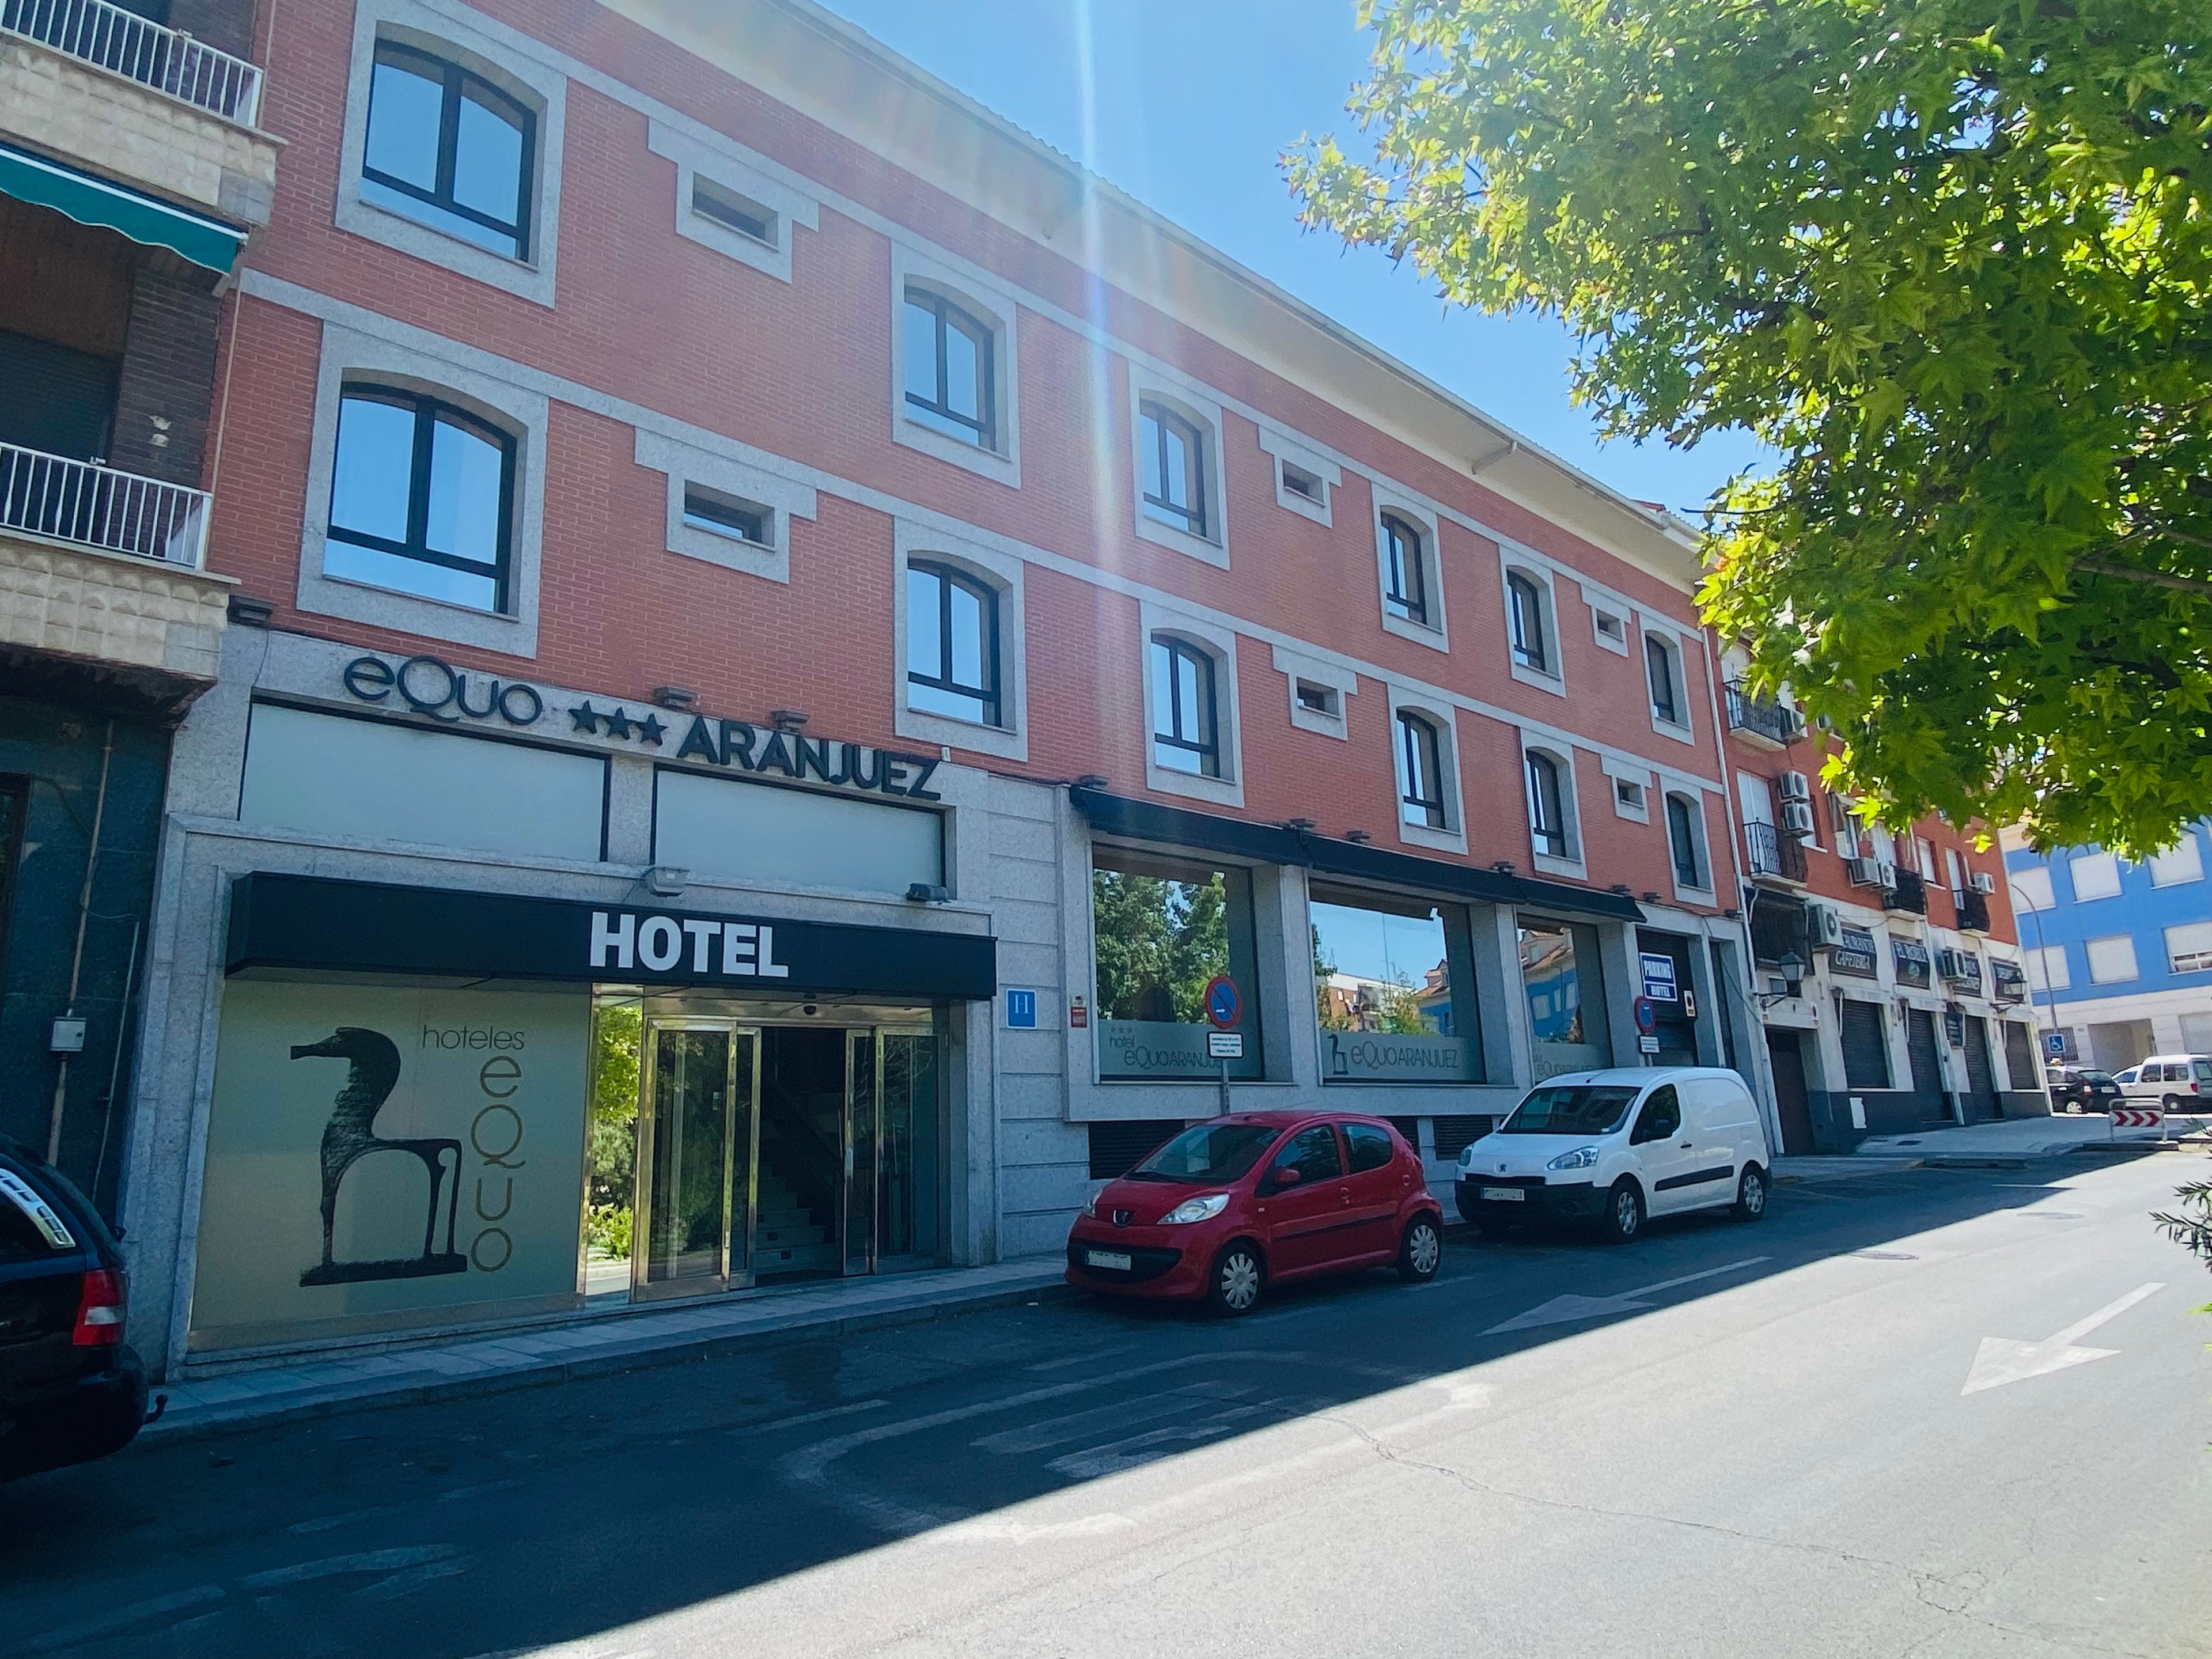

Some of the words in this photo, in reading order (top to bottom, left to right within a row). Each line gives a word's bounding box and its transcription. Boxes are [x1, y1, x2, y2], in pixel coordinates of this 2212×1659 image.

[677, 715, 941, 801] ARANJUEZ
[590, 911, 789, 978] HOTEL
[1014, 994, 1029, 1014] H
[422, 1025, 525, 1051] hoteles
[1109, 1035, 1135, 1049] hotel
